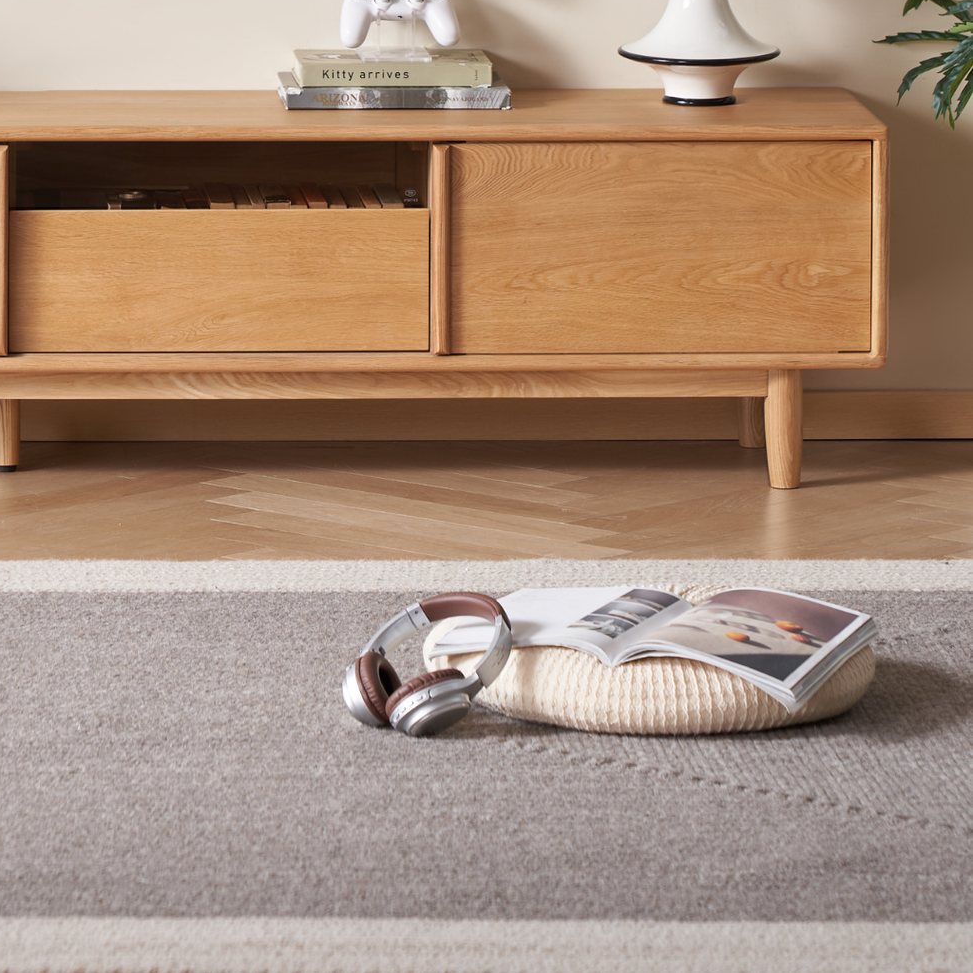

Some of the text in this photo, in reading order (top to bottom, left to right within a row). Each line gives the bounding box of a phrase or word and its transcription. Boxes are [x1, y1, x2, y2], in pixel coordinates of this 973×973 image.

[322, 69, 410, 81] Kitty arrives
[311, 93, 366, 102] ARIZONA
